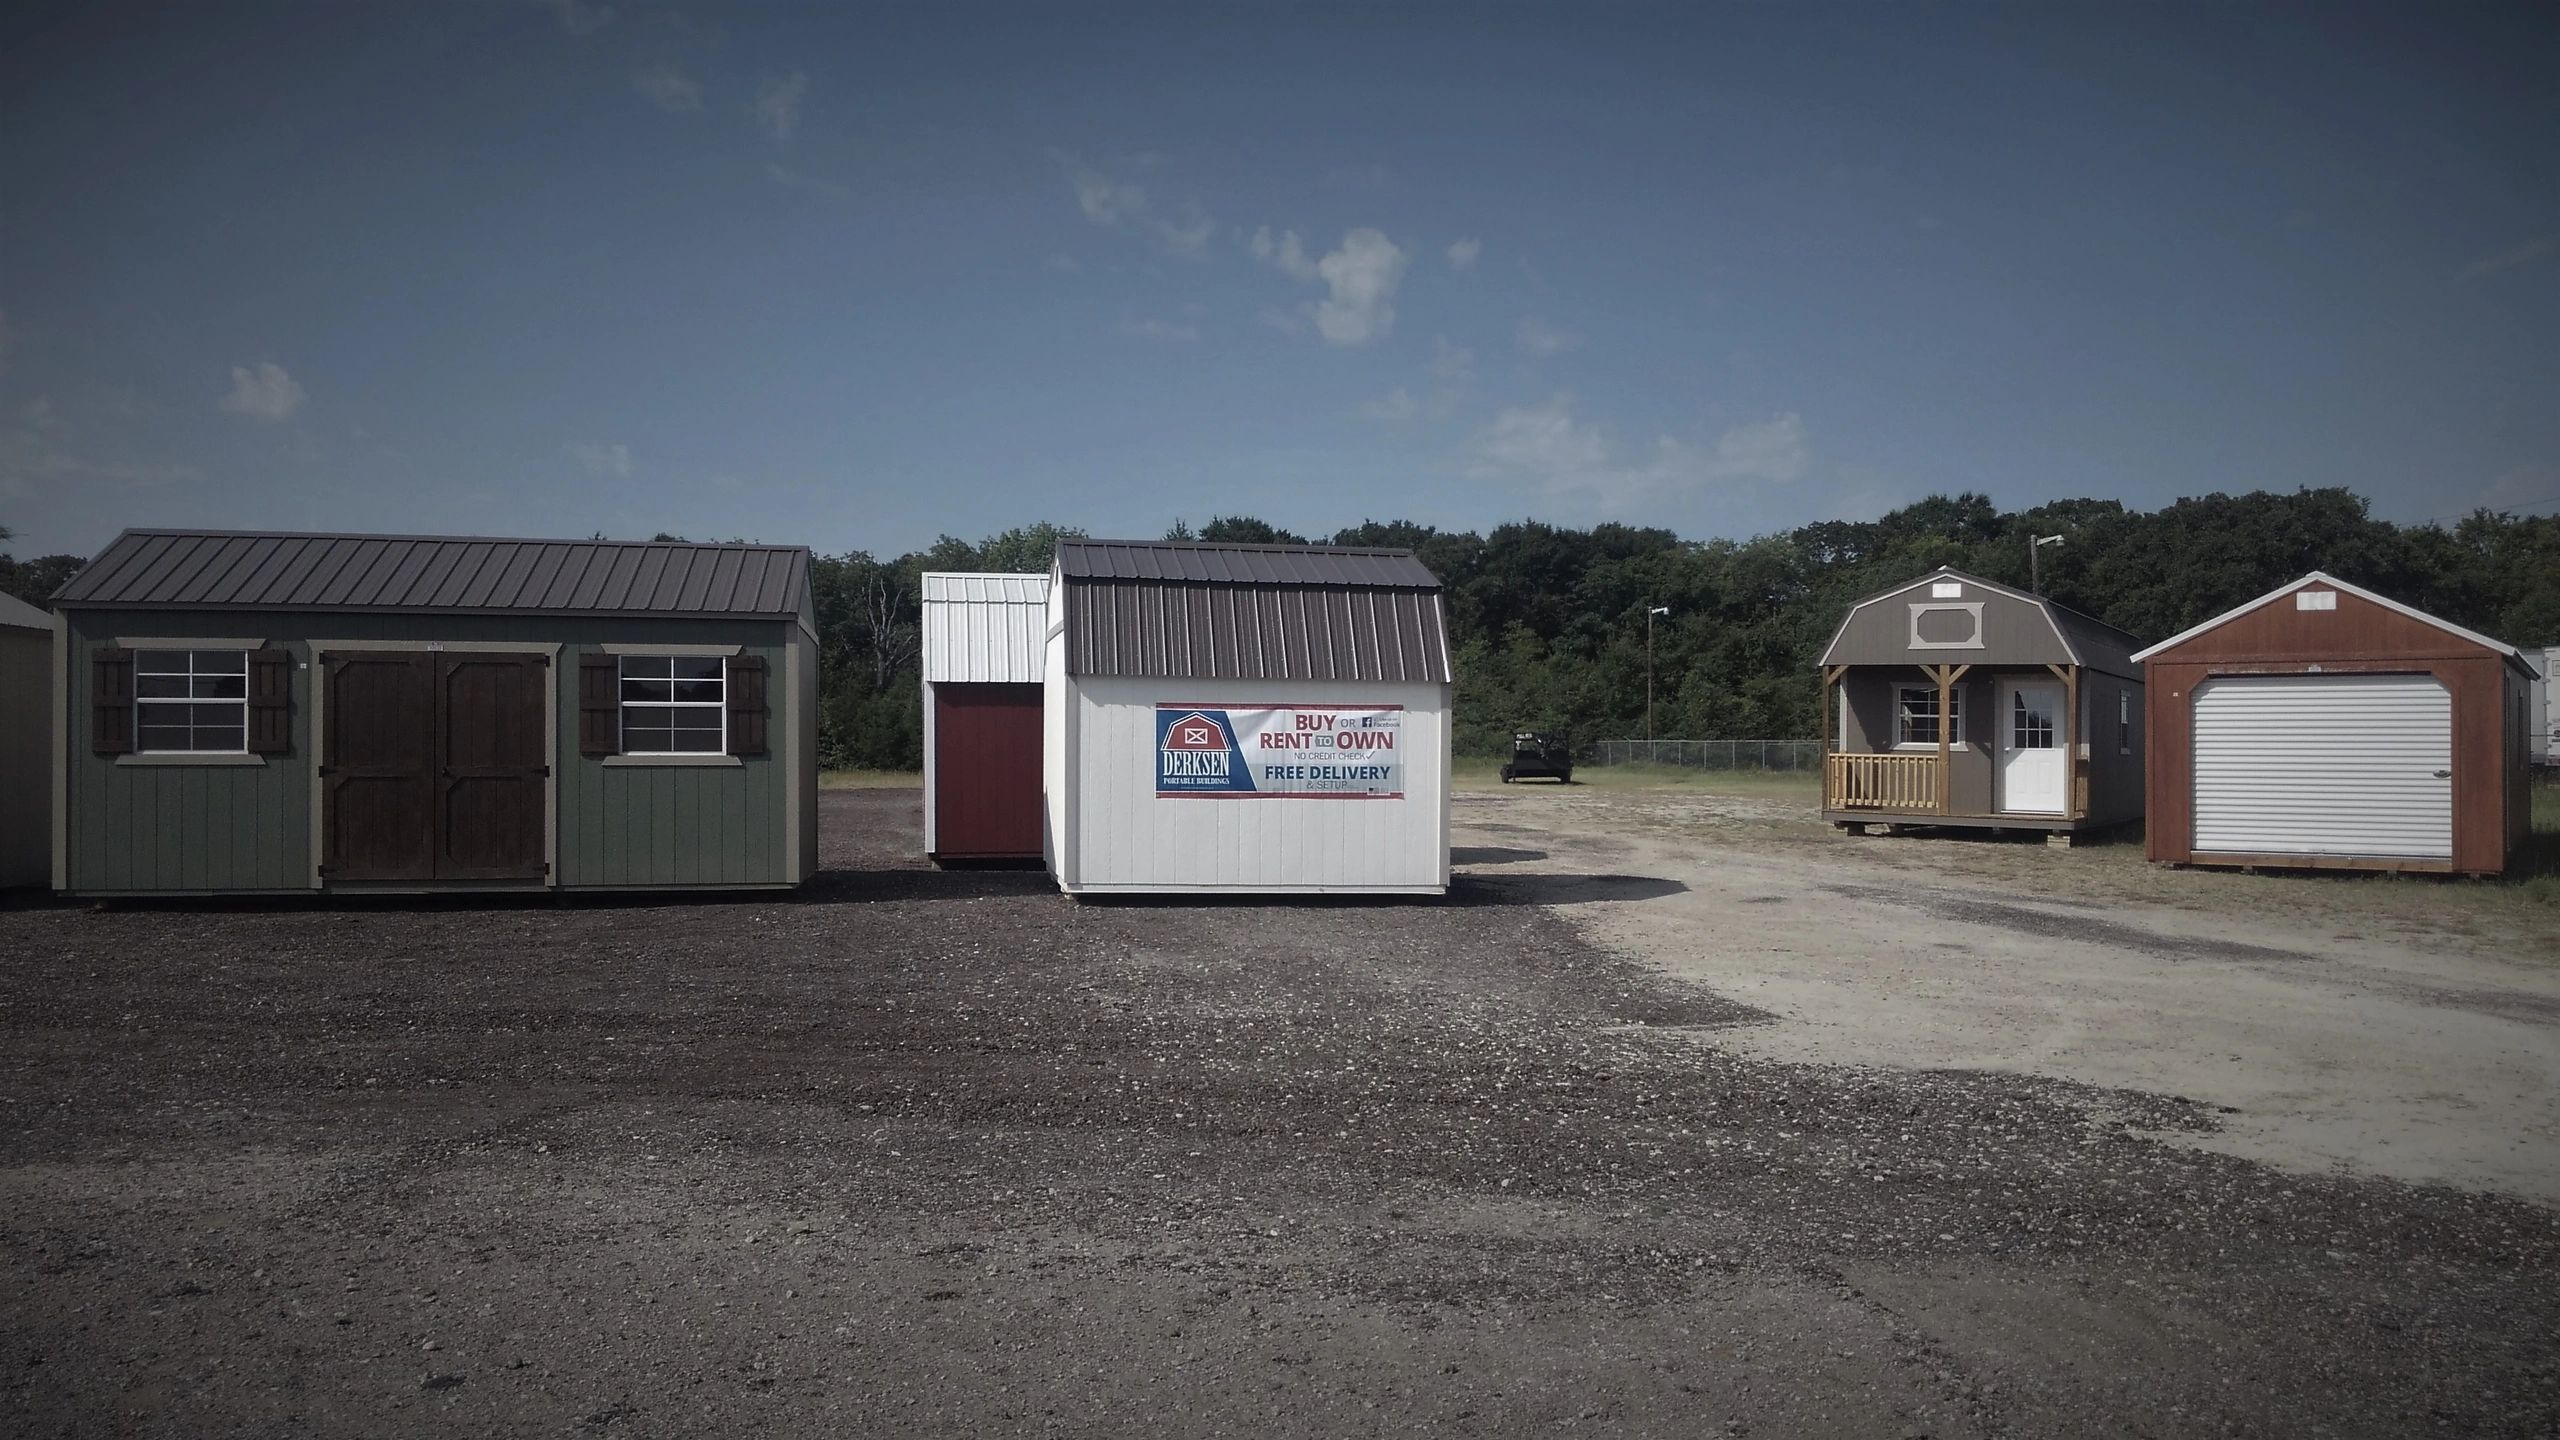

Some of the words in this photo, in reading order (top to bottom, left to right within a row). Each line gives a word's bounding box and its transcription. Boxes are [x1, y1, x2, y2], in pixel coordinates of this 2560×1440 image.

[1296, 714, 1336, 731] BUY
[1340, 718, 1356, 728] OR
[1260, 732, 1313, 749] RENT
[1317, 736, 1332, 746] TO
[1337, 731, 1393, 749] OWN
[1294, 752, 1307, 760] NO
[1308, 752, 1336, 760] CREDIT
[1338, 752, 1365, 760] CHECK
[1163, 751, 1230, 776] DERKSEN
[1265, 766, 1304, 779] FREE
[1309, 766, 1390, 780] DELIVERY
[1163, 777, 1195, 785] PORTABLE
[1196, 777, 1230, 785] BUILDINGS
[1306, 781, 1314, 789] &
[1316, 780, 1348, 790] SETUP
